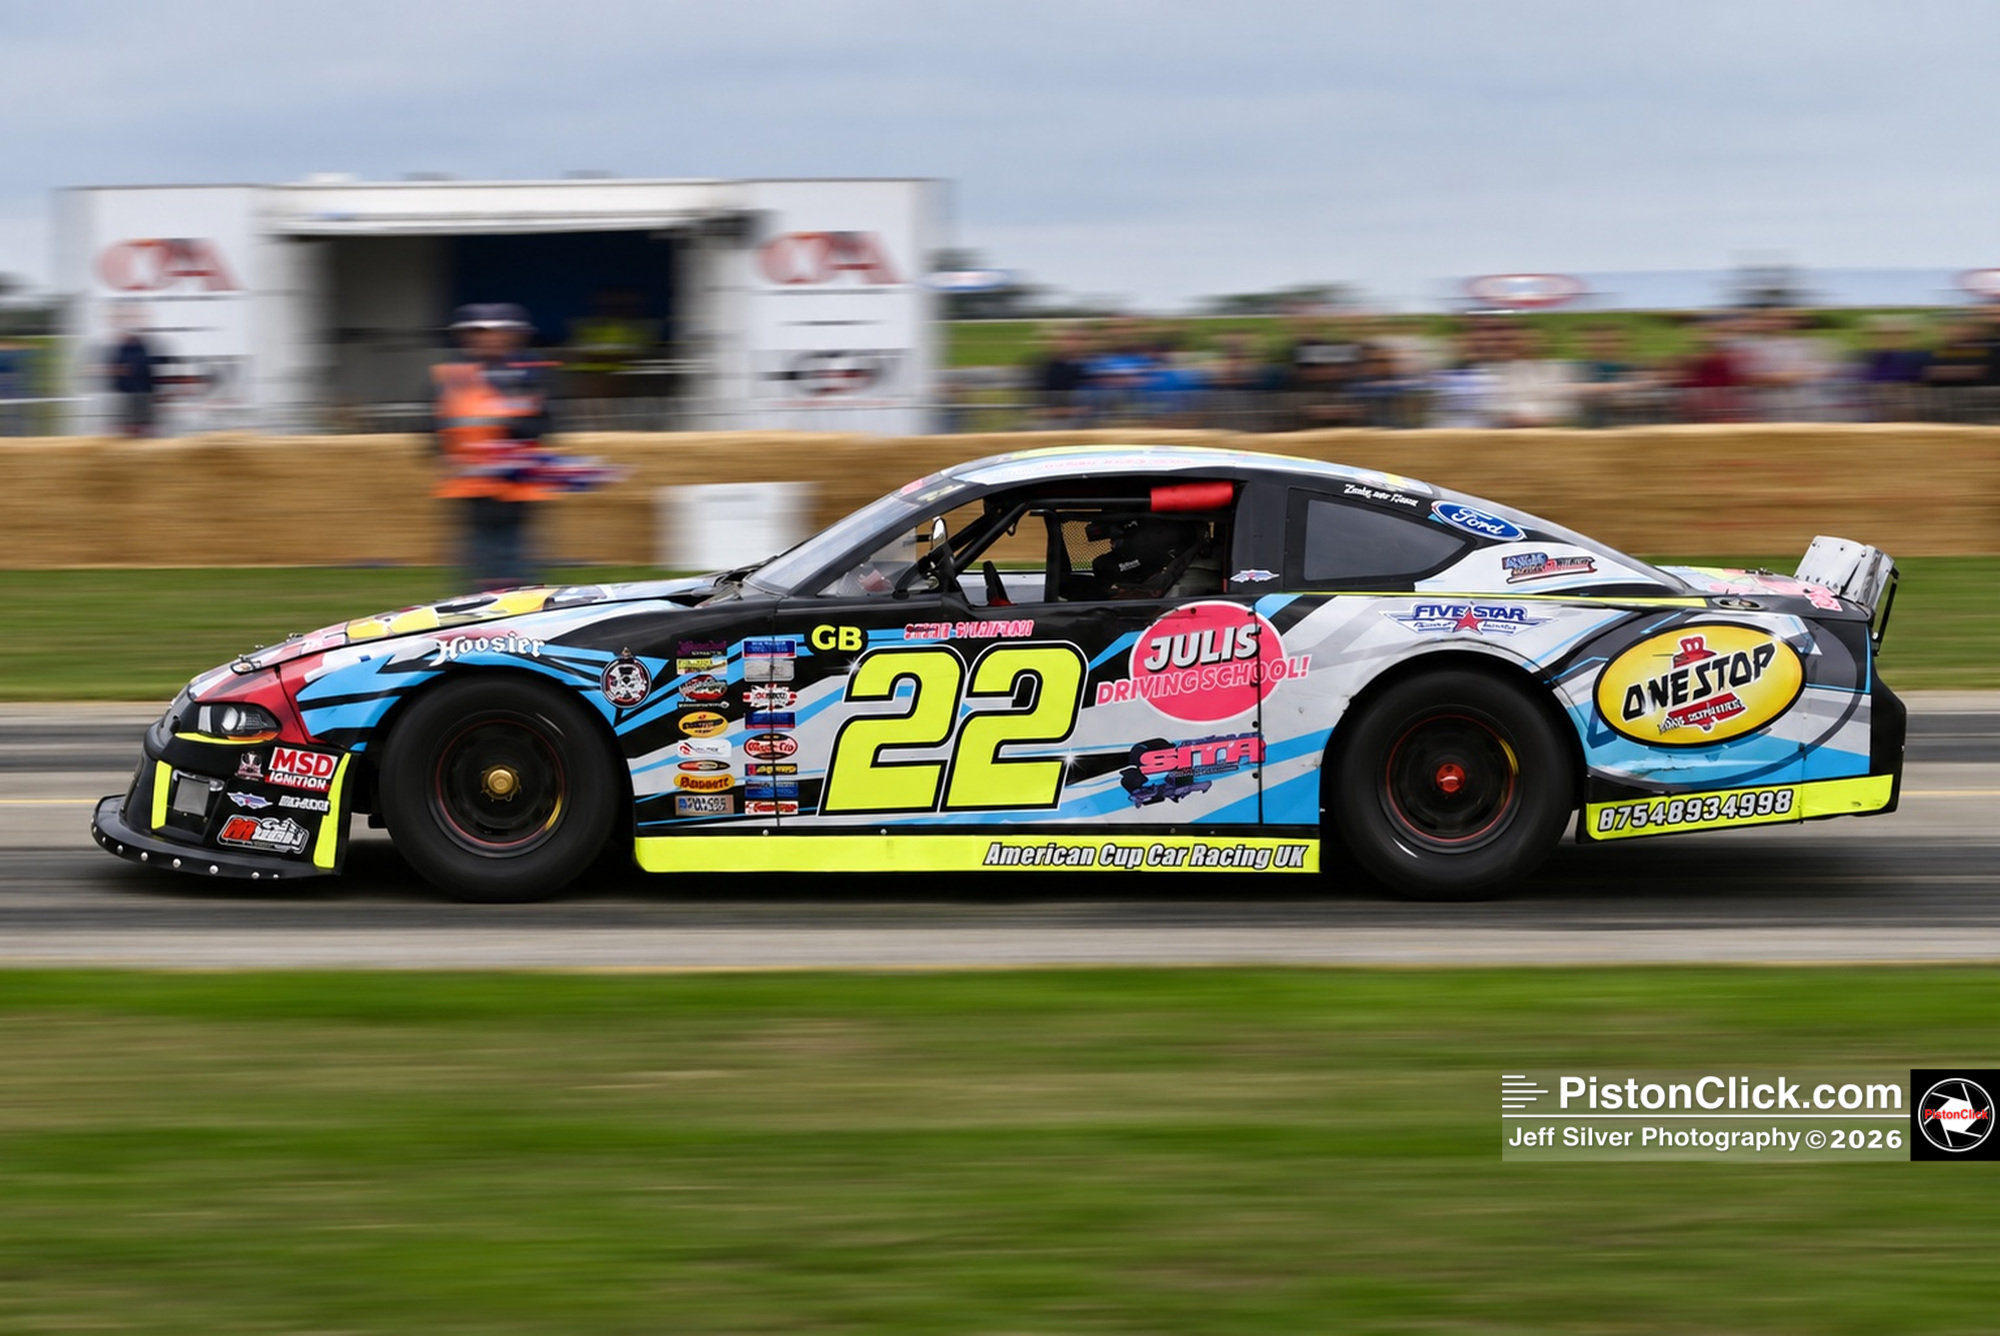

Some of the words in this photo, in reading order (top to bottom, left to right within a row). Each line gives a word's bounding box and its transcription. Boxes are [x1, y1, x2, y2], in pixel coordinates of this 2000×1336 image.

[1450, 506, 1506, 536] Ford
[1413, 605, 1465, 619] FIVE
[1473, 605, 1527, 621] STAR
[429, 630, 545, 667] Hoosier
[811, 625, 863, 651] GB
[1144, 623, 1262, 673] JULIS
[1096, 671, 1199, 706] DRIVING
[1201, 654, 1312, 690] SCHOOL!
[821, 643, 1086, 814] 22
[272, 748, 334, 778] MSD
[269, 772, 327, 790] IGNITION
[983, 842, 1096, 867] American
[1099, 843, 1143, 869] Cup
[1147, 844, 1189, 867] Car
[1189, 844, 1273, 871] Racing
[1275, 845, 1308, 868] UK
